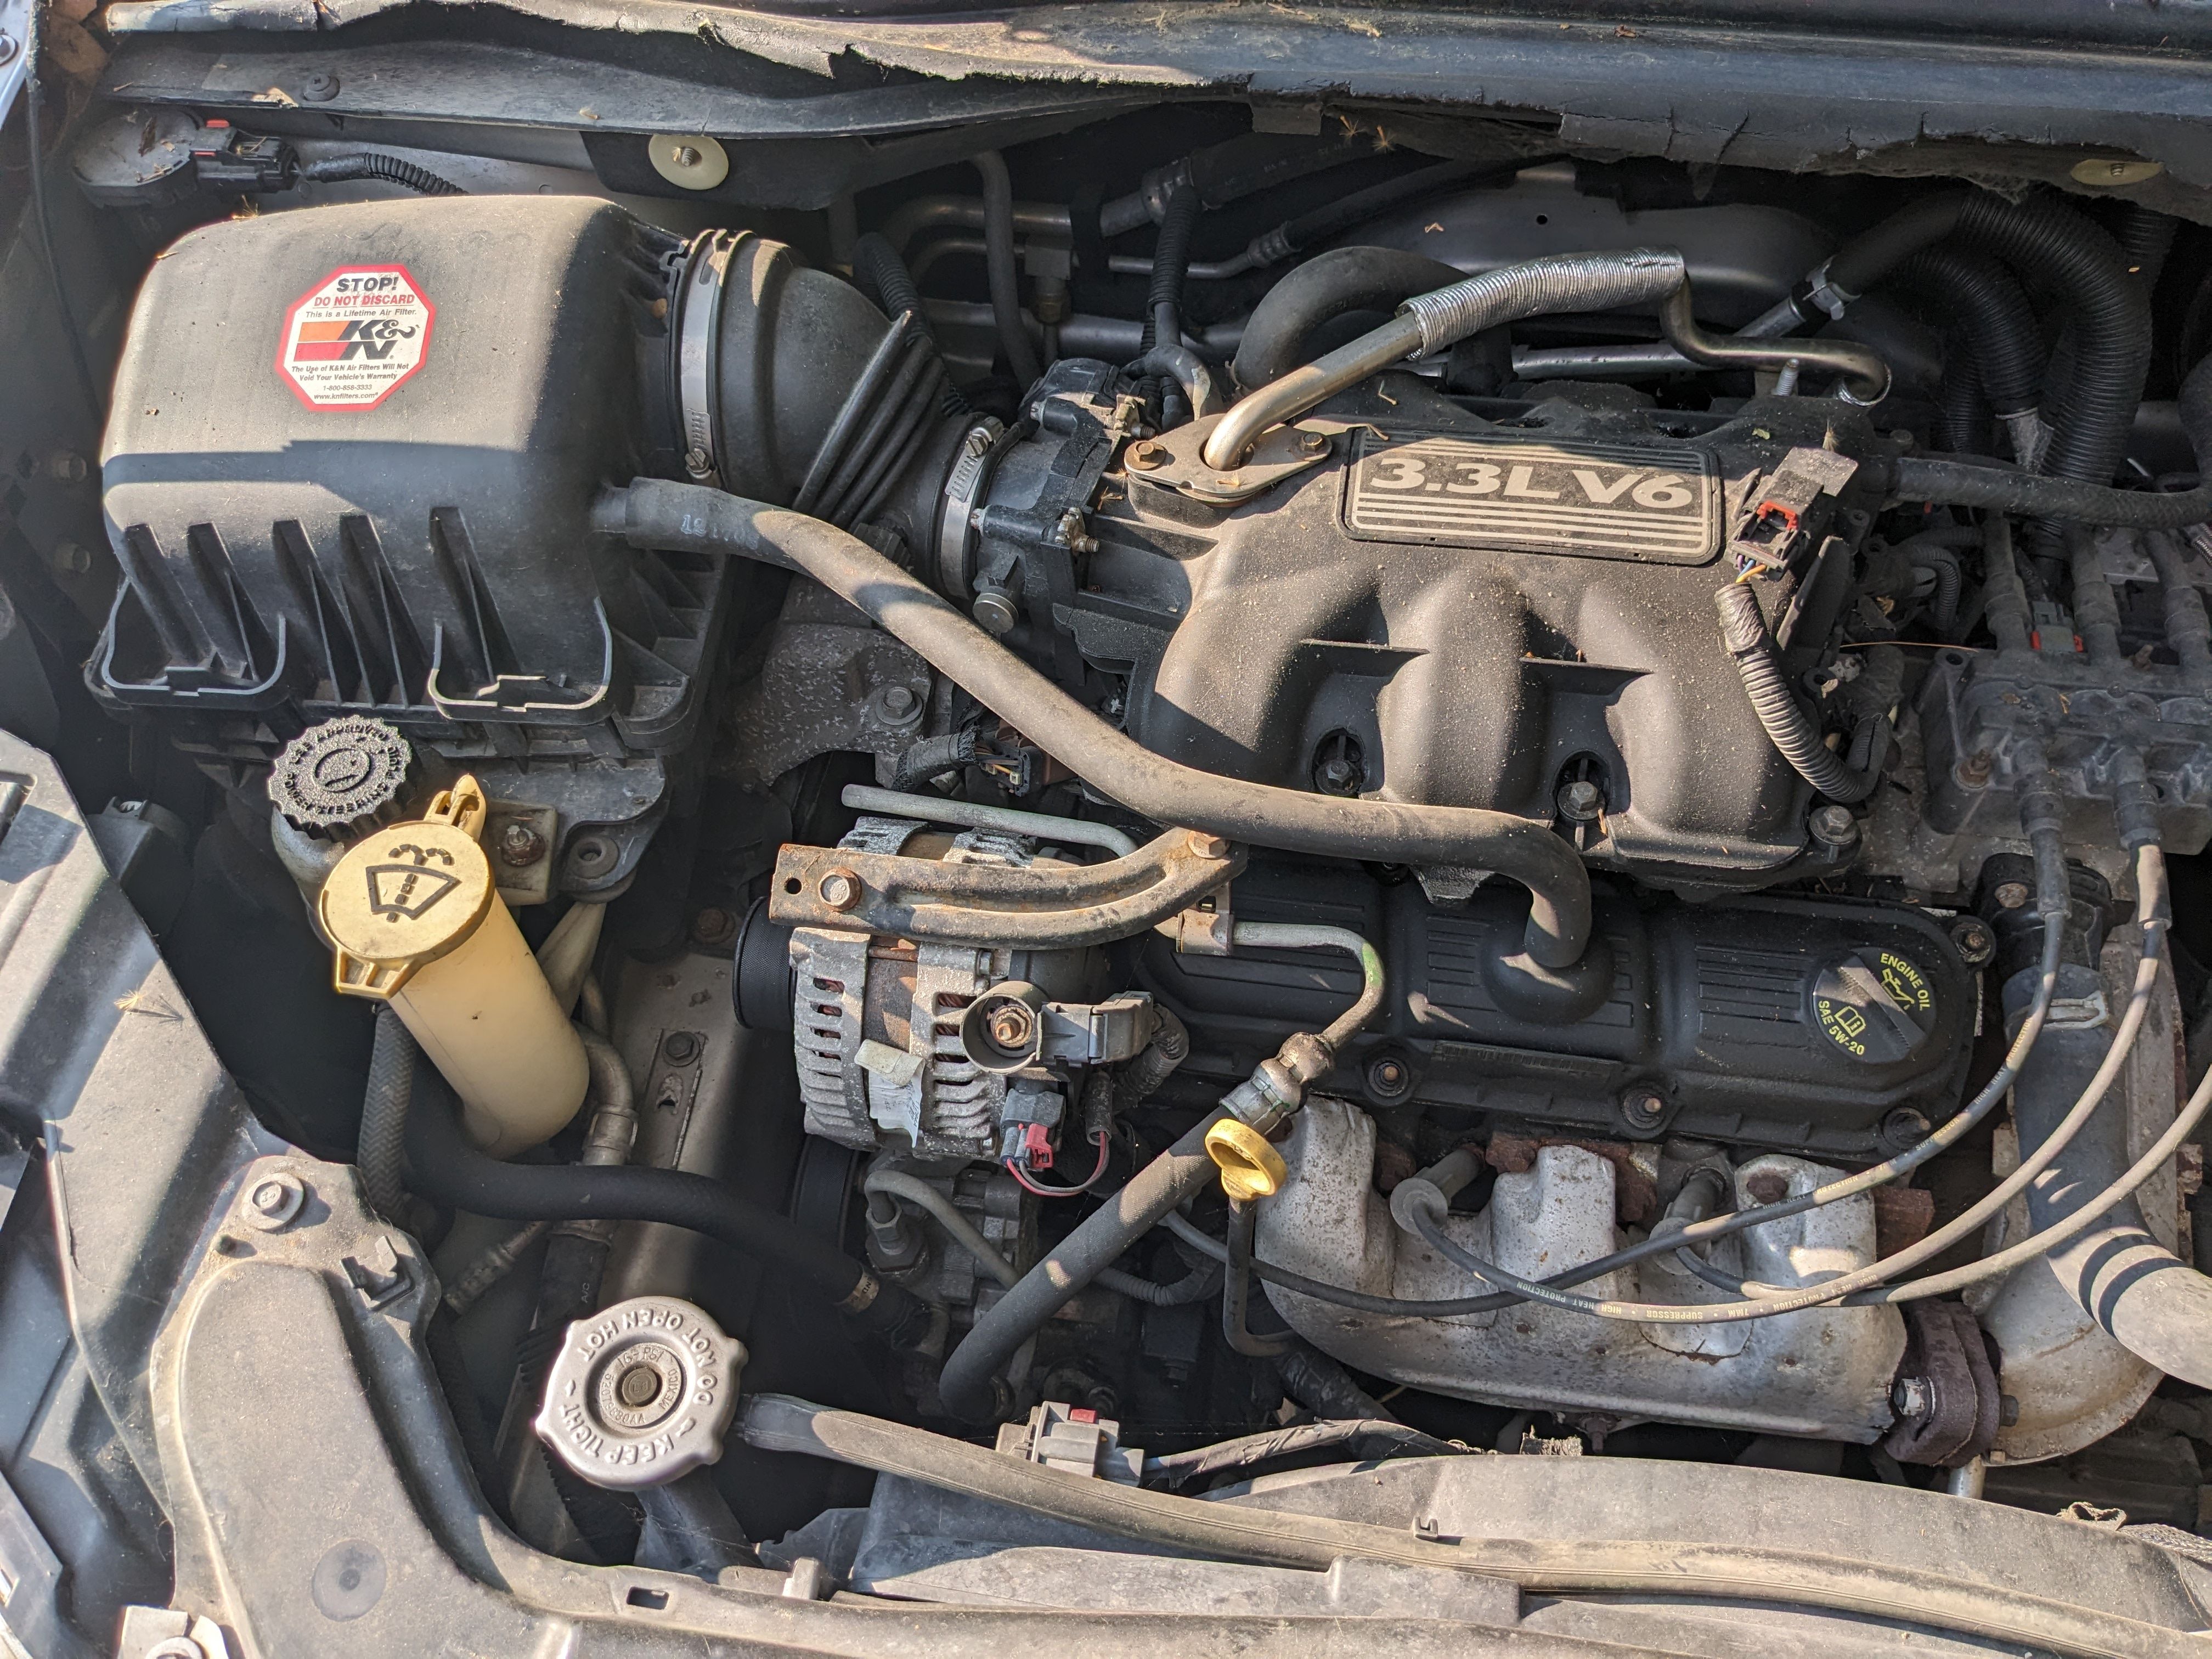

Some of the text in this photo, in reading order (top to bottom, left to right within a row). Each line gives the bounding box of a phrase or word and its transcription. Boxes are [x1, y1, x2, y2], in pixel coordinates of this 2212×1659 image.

[336, 277, 399, 292] STOP!
[313, 295, 415, 307] DO NOT DISCARD
[344, 309, 376, 317] Lifetime
[1371, 458, 1692, 509] 3.3L V6
[1880, 953, 1931, 1011] ENGINE OIL
[1818, 1000, 1865, 1056] SAE 5W-20
[1915, 1118, 1960, 1152] SUPPRESSOR
[1974, 1088, 1990, 1105] HIGH
[1516, 1280, 1566, 1303] PROTECTION
[1572, 1299, 1594, 1310] HEAT
[1601, 1304, 1622, 1314] HIGH
[1646, 1308, 1703, 1319] SUPPRESSOR
[1728, 1307, 1750, 1317] 7MM
[578, 1308, 718, 1406] DO NOT OPEN HOT
[658, 1368, 679, 1410] MEXICO
[557, 1403, 675, 1465] KEEP TIGHT
